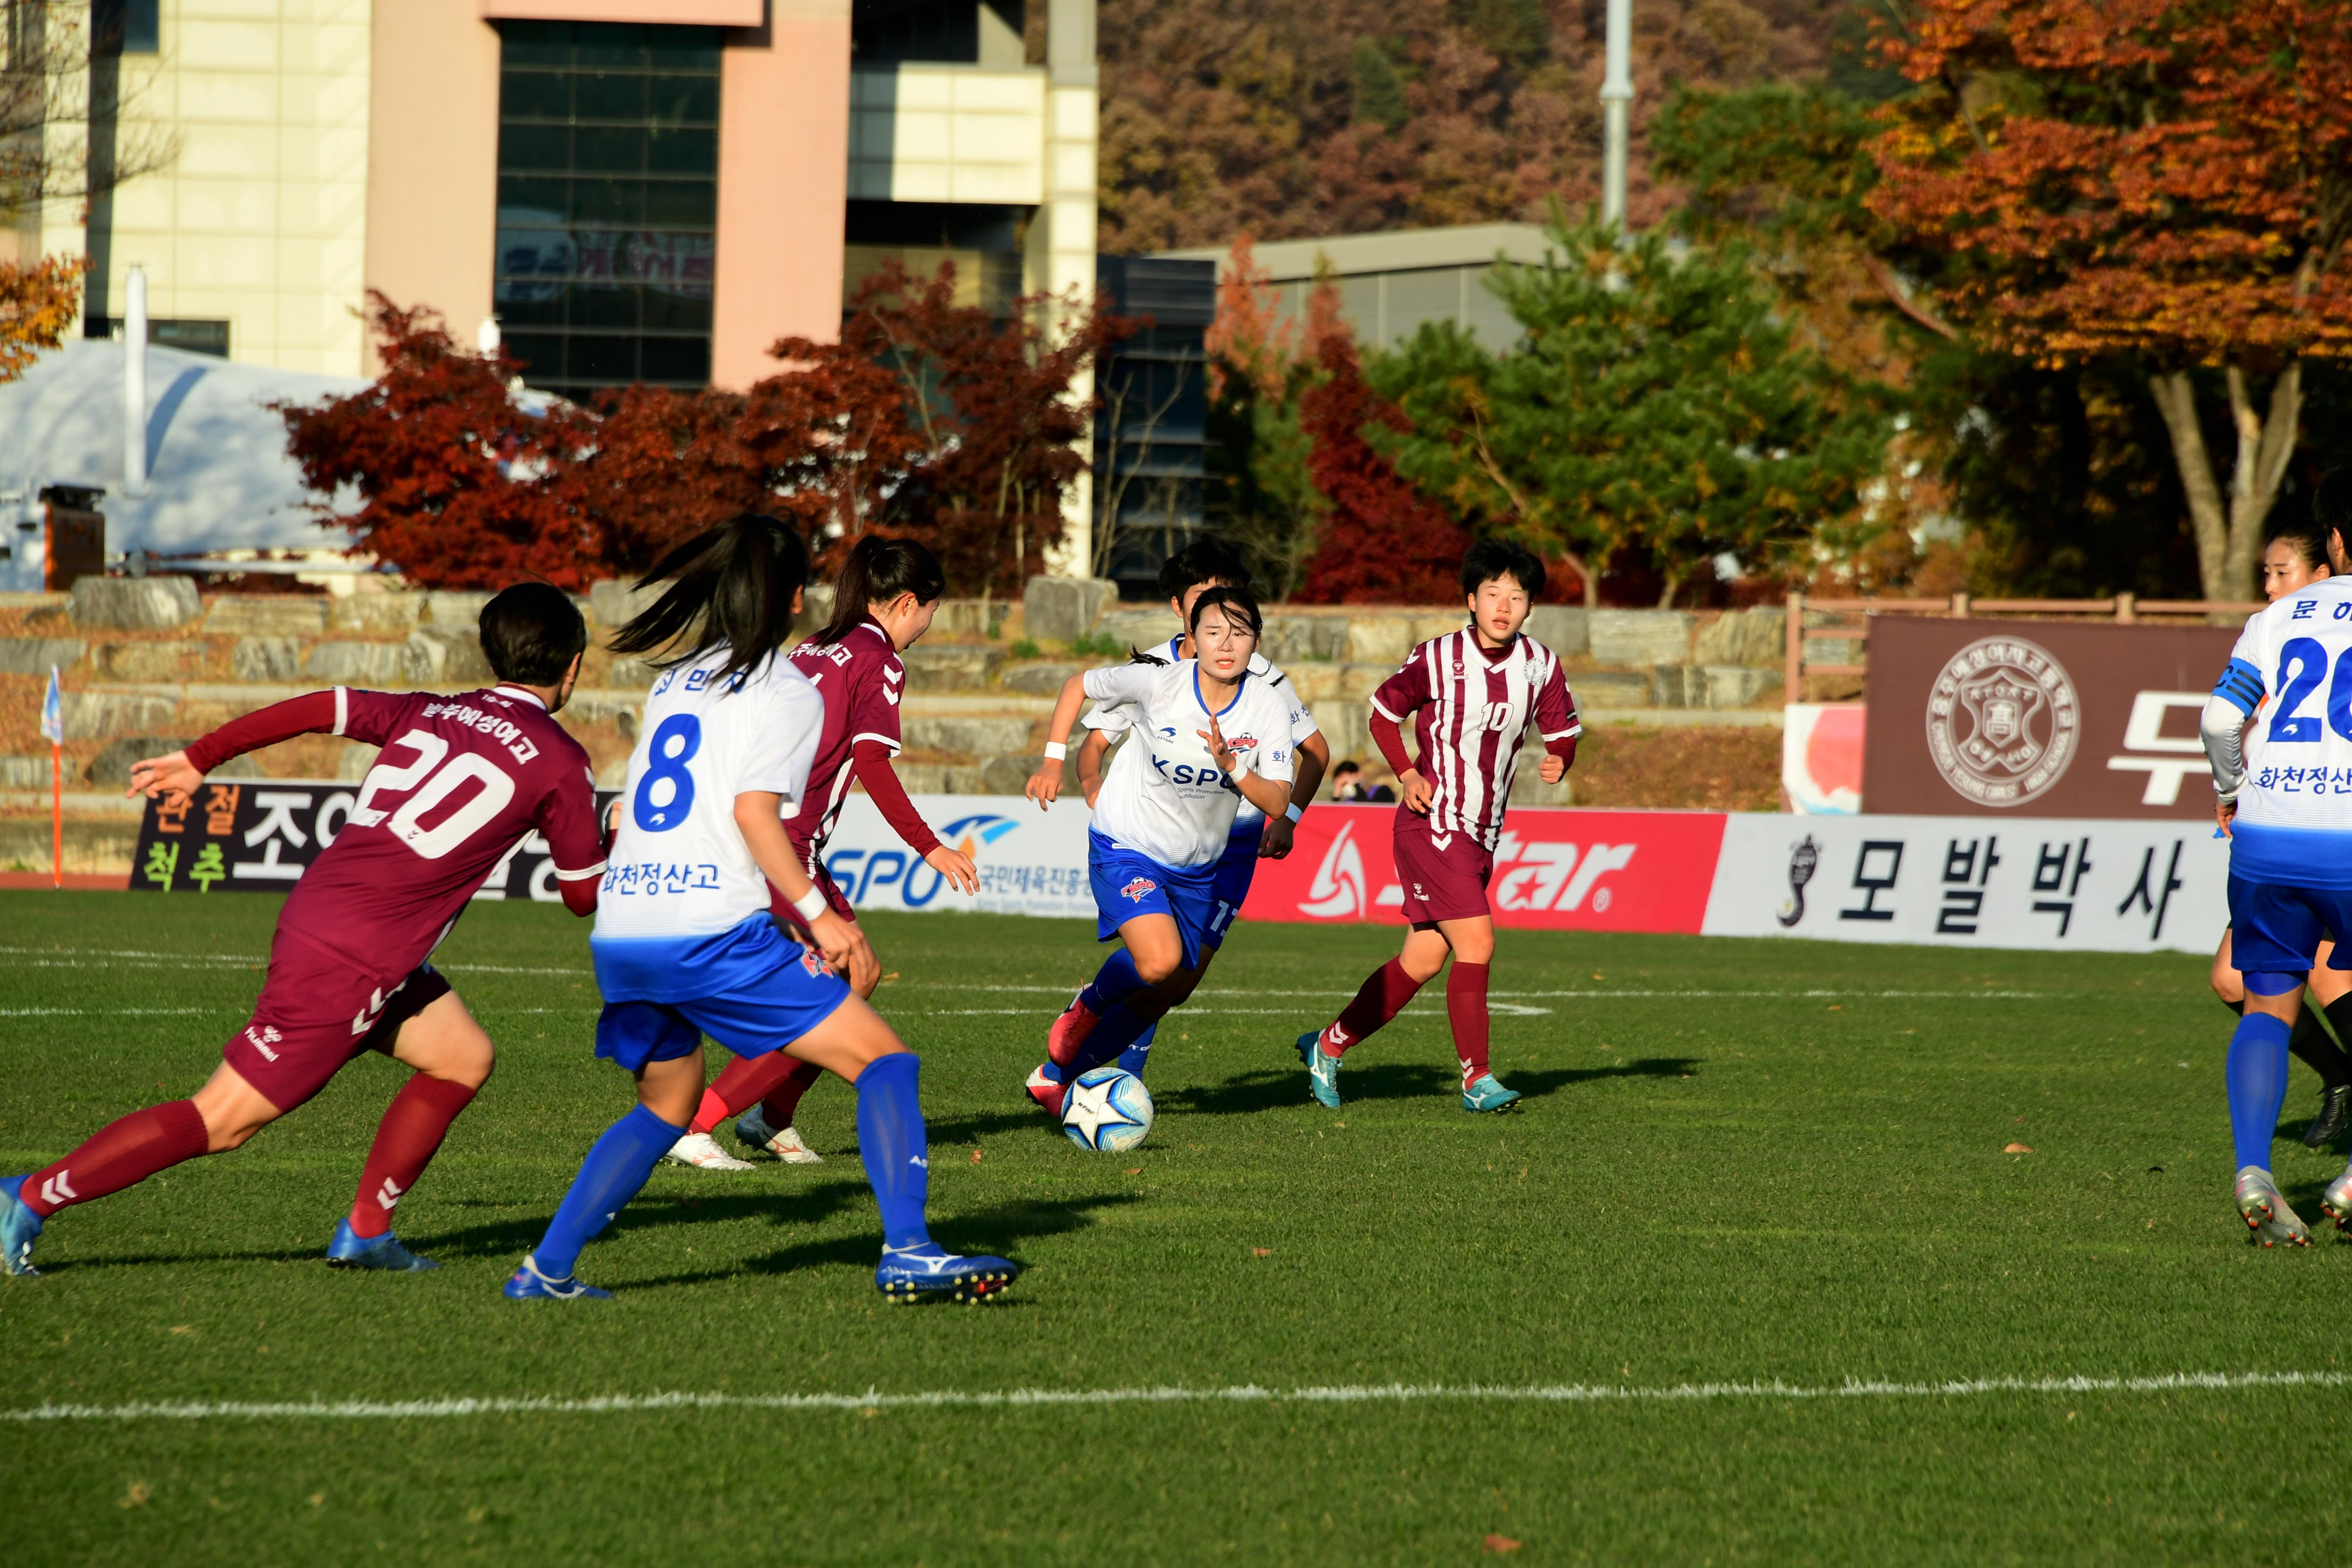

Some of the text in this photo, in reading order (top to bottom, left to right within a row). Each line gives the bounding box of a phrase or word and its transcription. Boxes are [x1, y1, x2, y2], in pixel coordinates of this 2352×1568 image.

[1478, 702, 1514, 731] 10
[1157, 735, 1174, 744] ASTORE
[1227, 738, 1258, 749] KSPO
[634, 713, 702, 832] 8
[344, 729, 515, 859] 20
[144, 841, 226, 893] 척추
[603, 863, 721, 896] 화천정산고
[1837, 835, 2183, 941] 모발박사
[245, 1026, 280, 1062] hummel
